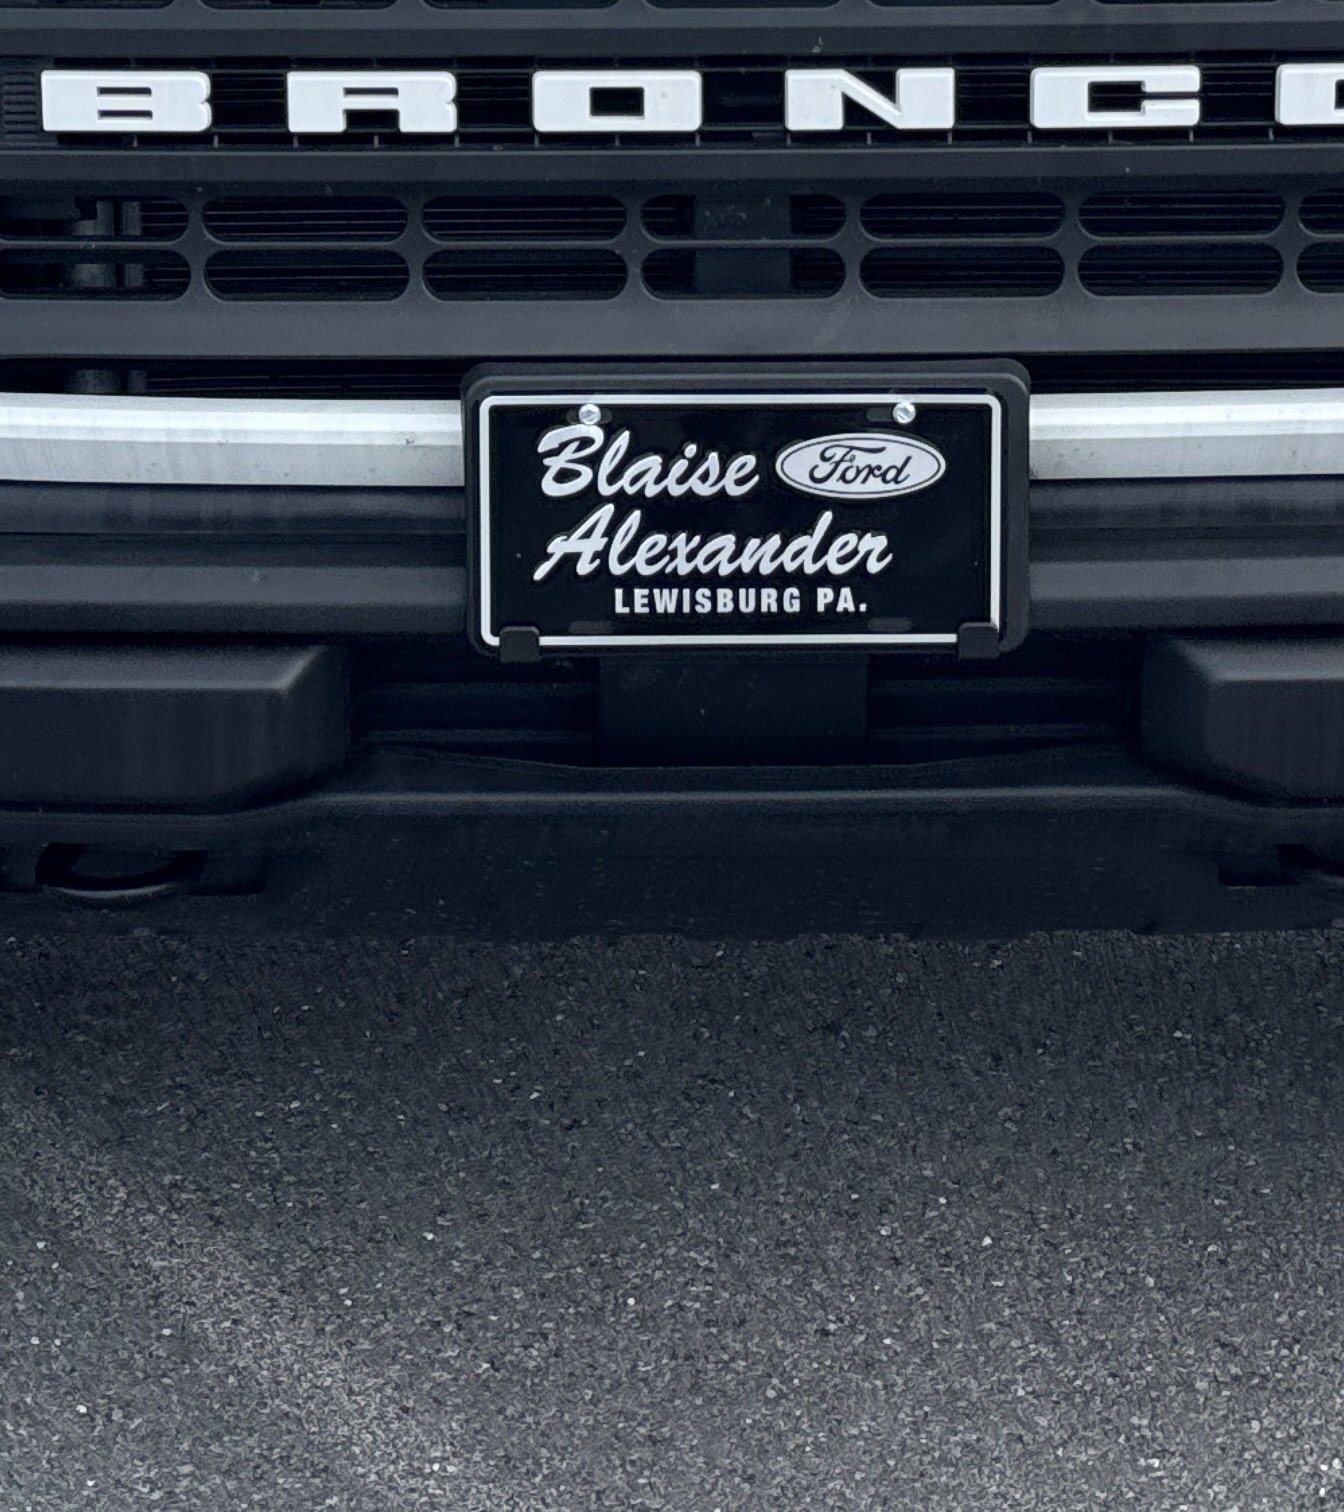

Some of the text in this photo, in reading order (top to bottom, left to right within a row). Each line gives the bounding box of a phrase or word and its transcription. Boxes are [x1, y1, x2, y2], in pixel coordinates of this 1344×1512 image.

[537, 424, 760, 497] Blaise
[808, 444, 913, 486] Ford
[533, 503, 894, 582] Alexander
[614, 587, 868, 615] LEWISBURG PA.
